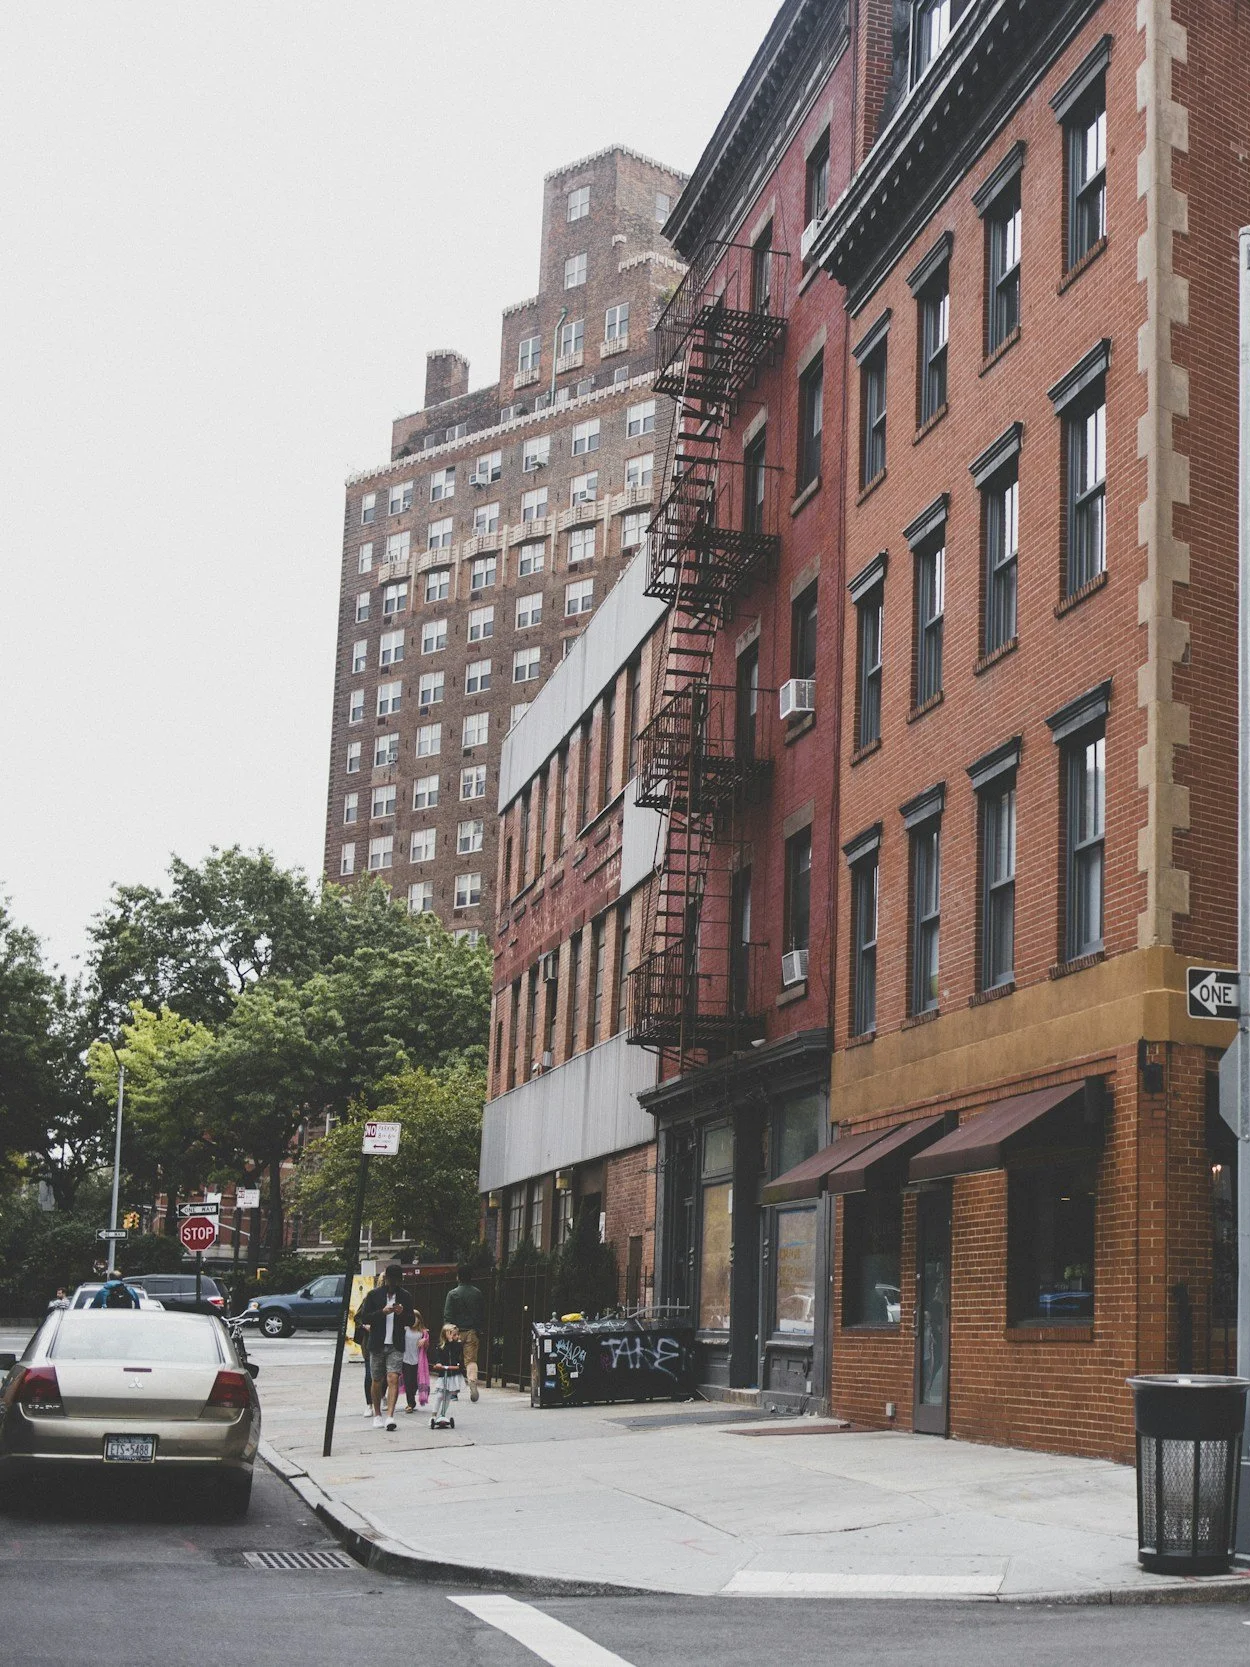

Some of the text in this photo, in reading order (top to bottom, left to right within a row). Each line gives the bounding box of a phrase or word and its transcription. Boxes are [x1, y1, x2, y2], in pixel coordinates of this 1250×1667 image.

[1200, 984, 1232, 1004] ONE
[364, 1124, 376, 1137] NO
[183, 1226, 214, 1241] STOP
